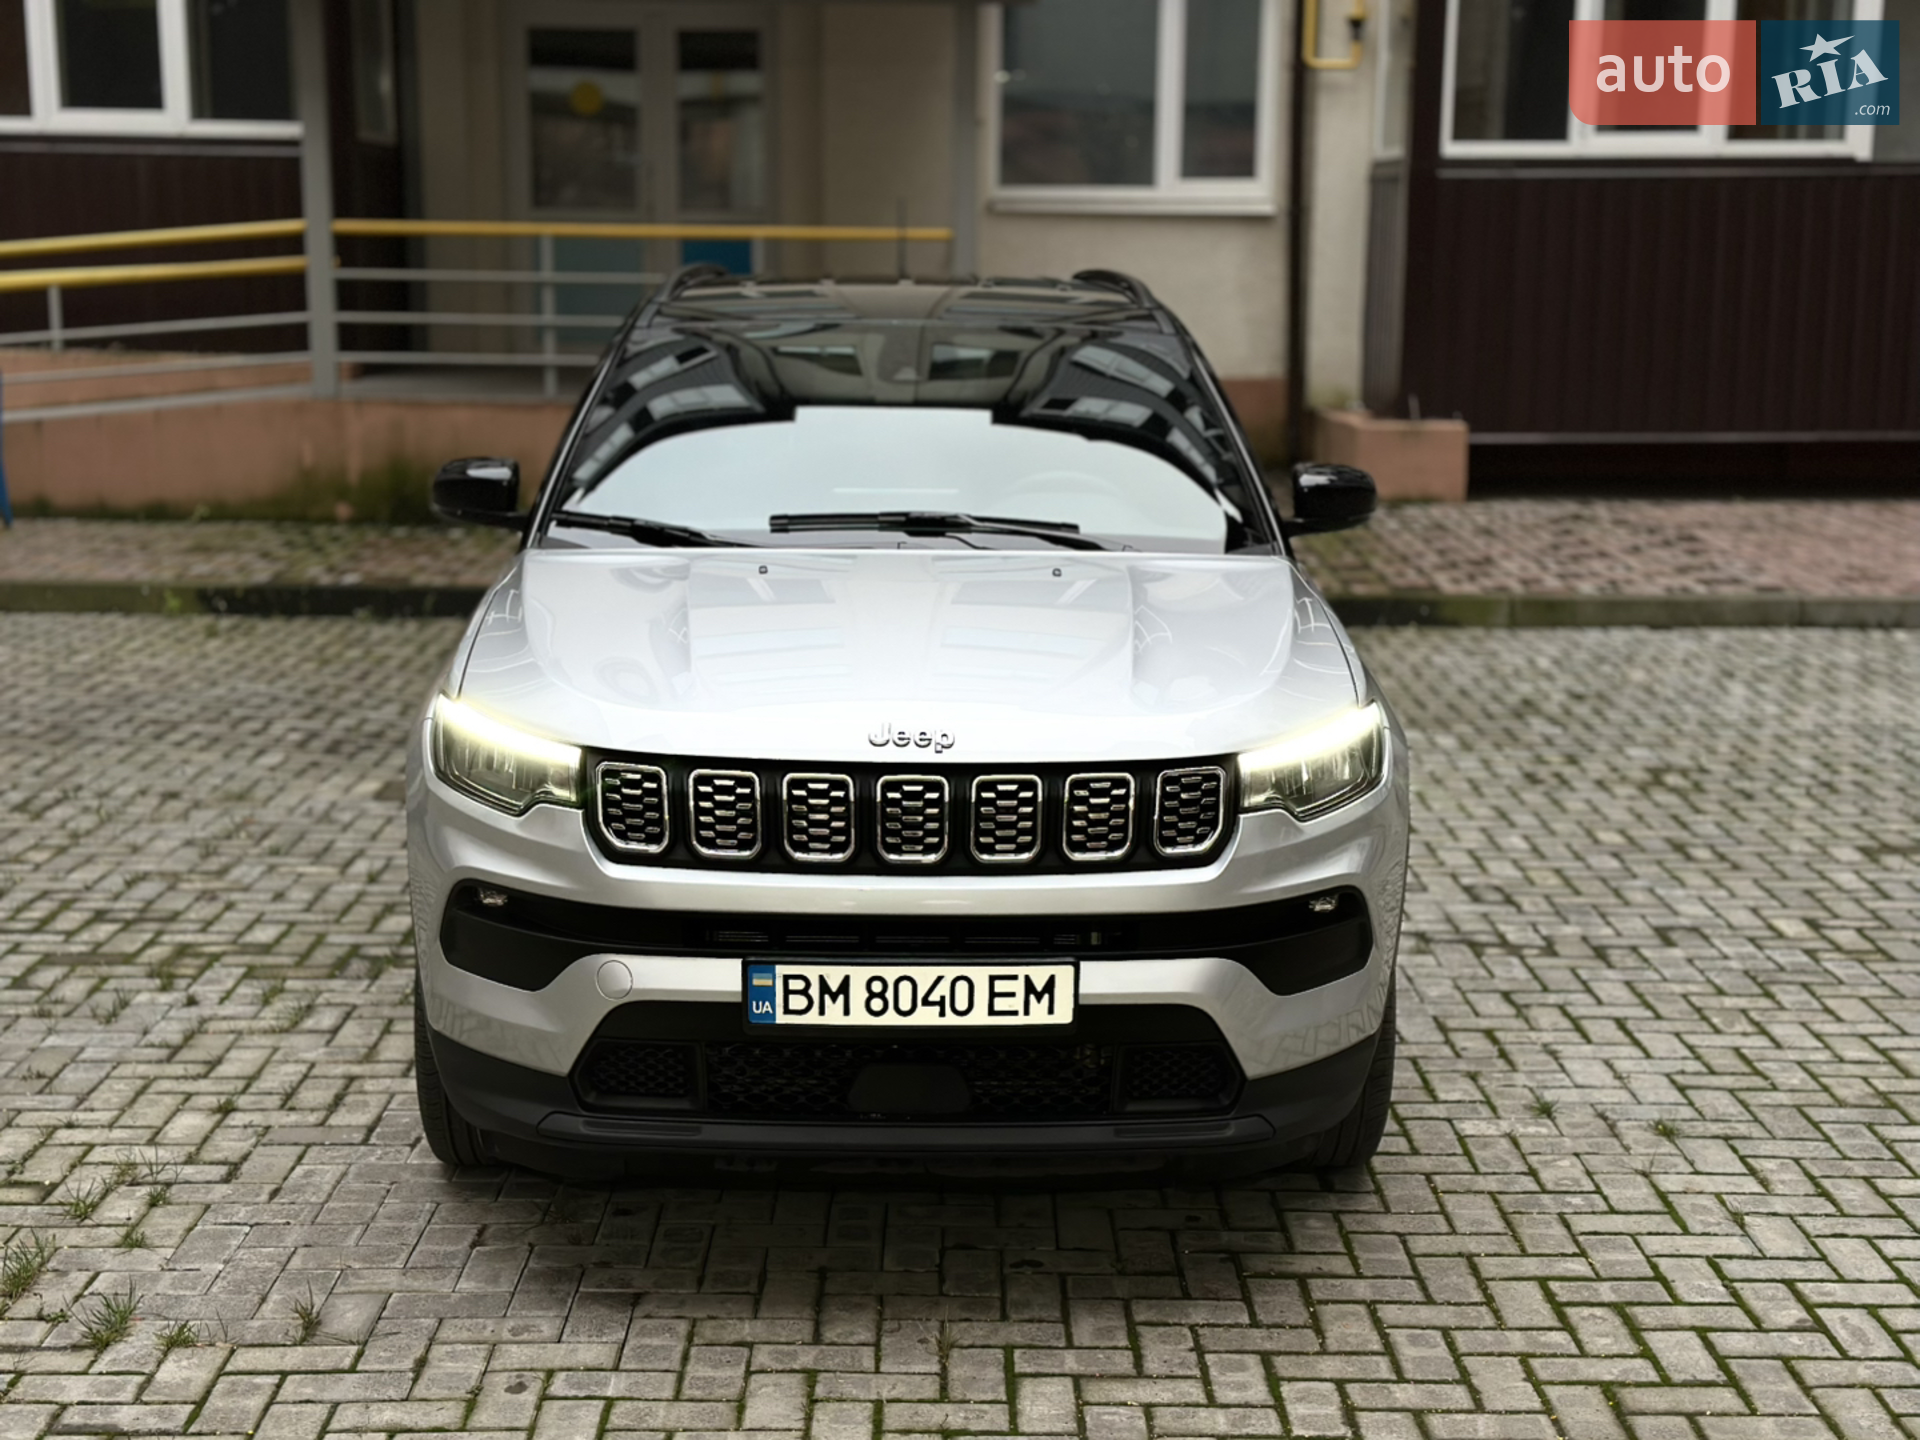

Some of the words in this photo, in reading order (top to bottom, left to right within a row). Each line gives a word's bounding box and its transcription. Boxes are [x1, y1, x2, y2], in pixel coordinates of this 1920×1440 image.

[868, 722, 955, 754] Jeep
[752, 1000, 773, 1014] UA
[782, 973, 851, 1017] BM
[864, 974, 975, 1018] 8040
[987, 973, 1056, 1017] EM
